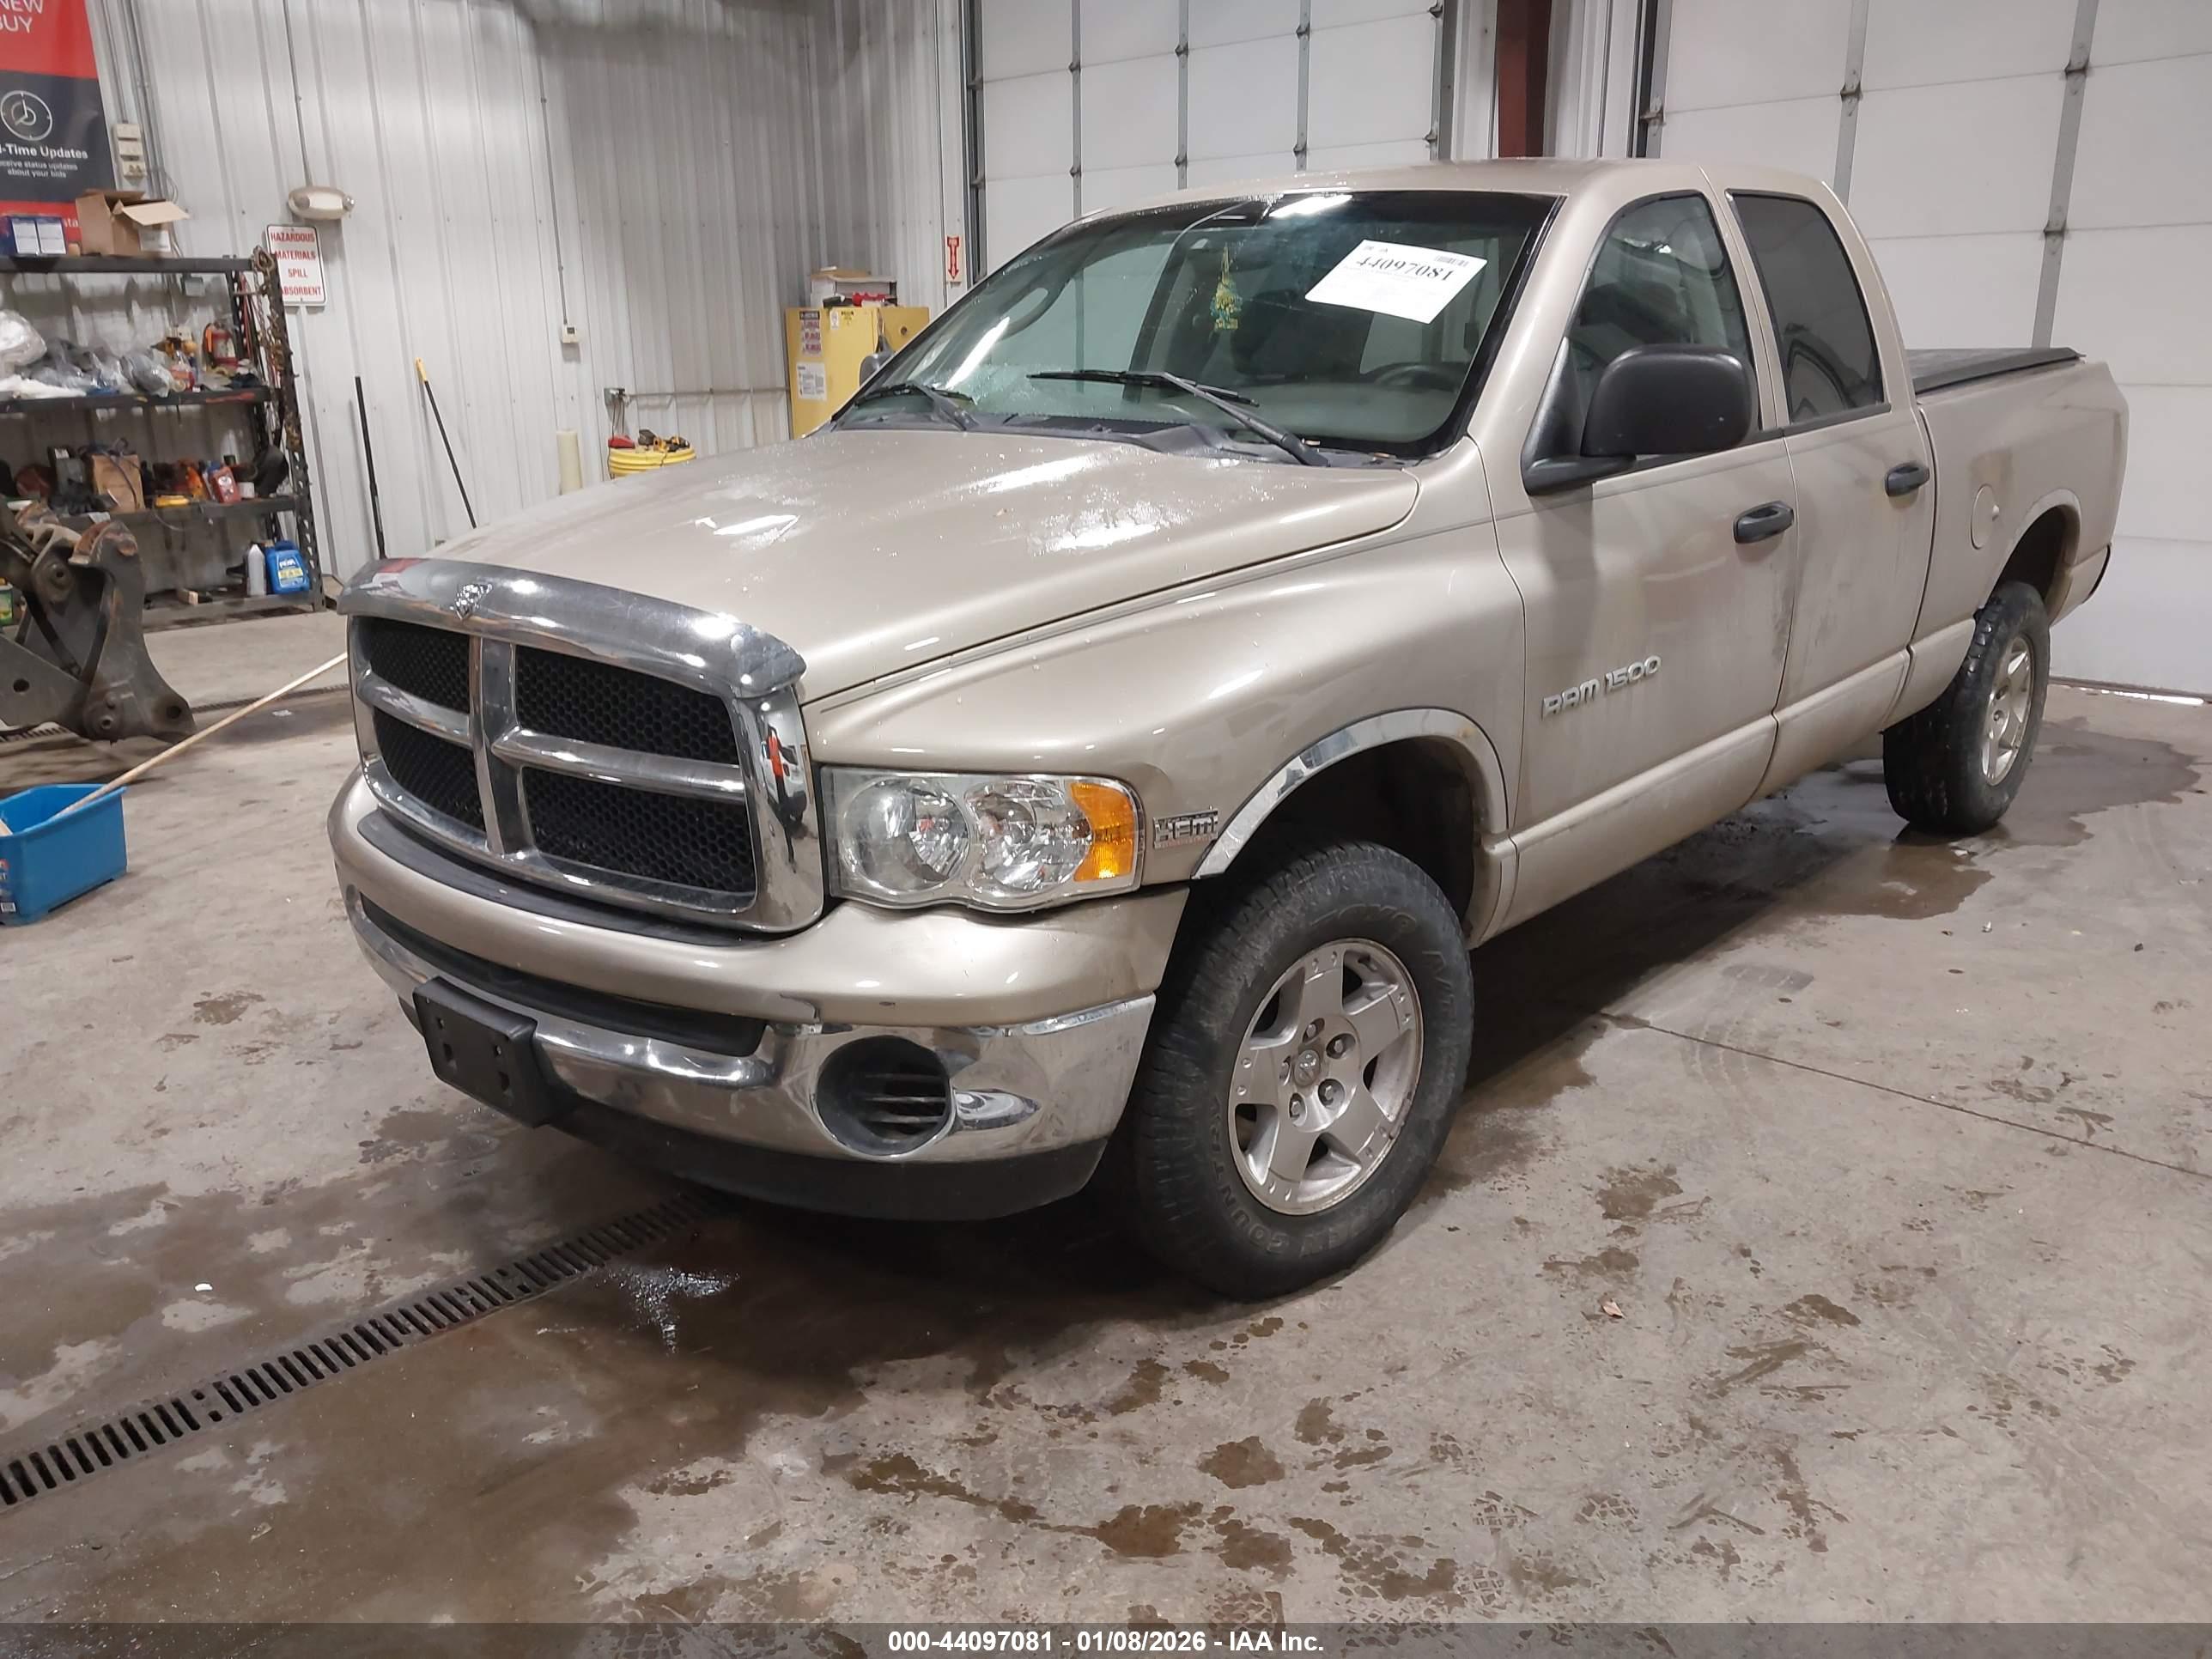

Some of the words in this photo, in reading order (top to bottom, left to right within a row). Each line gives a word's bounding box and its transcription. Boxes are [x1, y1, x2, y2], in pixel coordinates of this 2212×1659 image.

[40, 146, 88, 159] Updates
[270, 233, 315, 242] HAZARDOUS
[275, 250, 316, 260] MATERIALS
[289, 268, 307, 277] SPILL
[1357, 257, 1454, 281] 44097081
[1541, 678, 1601, 719] RAM
[1604, 654, 1662, 693] 1500
